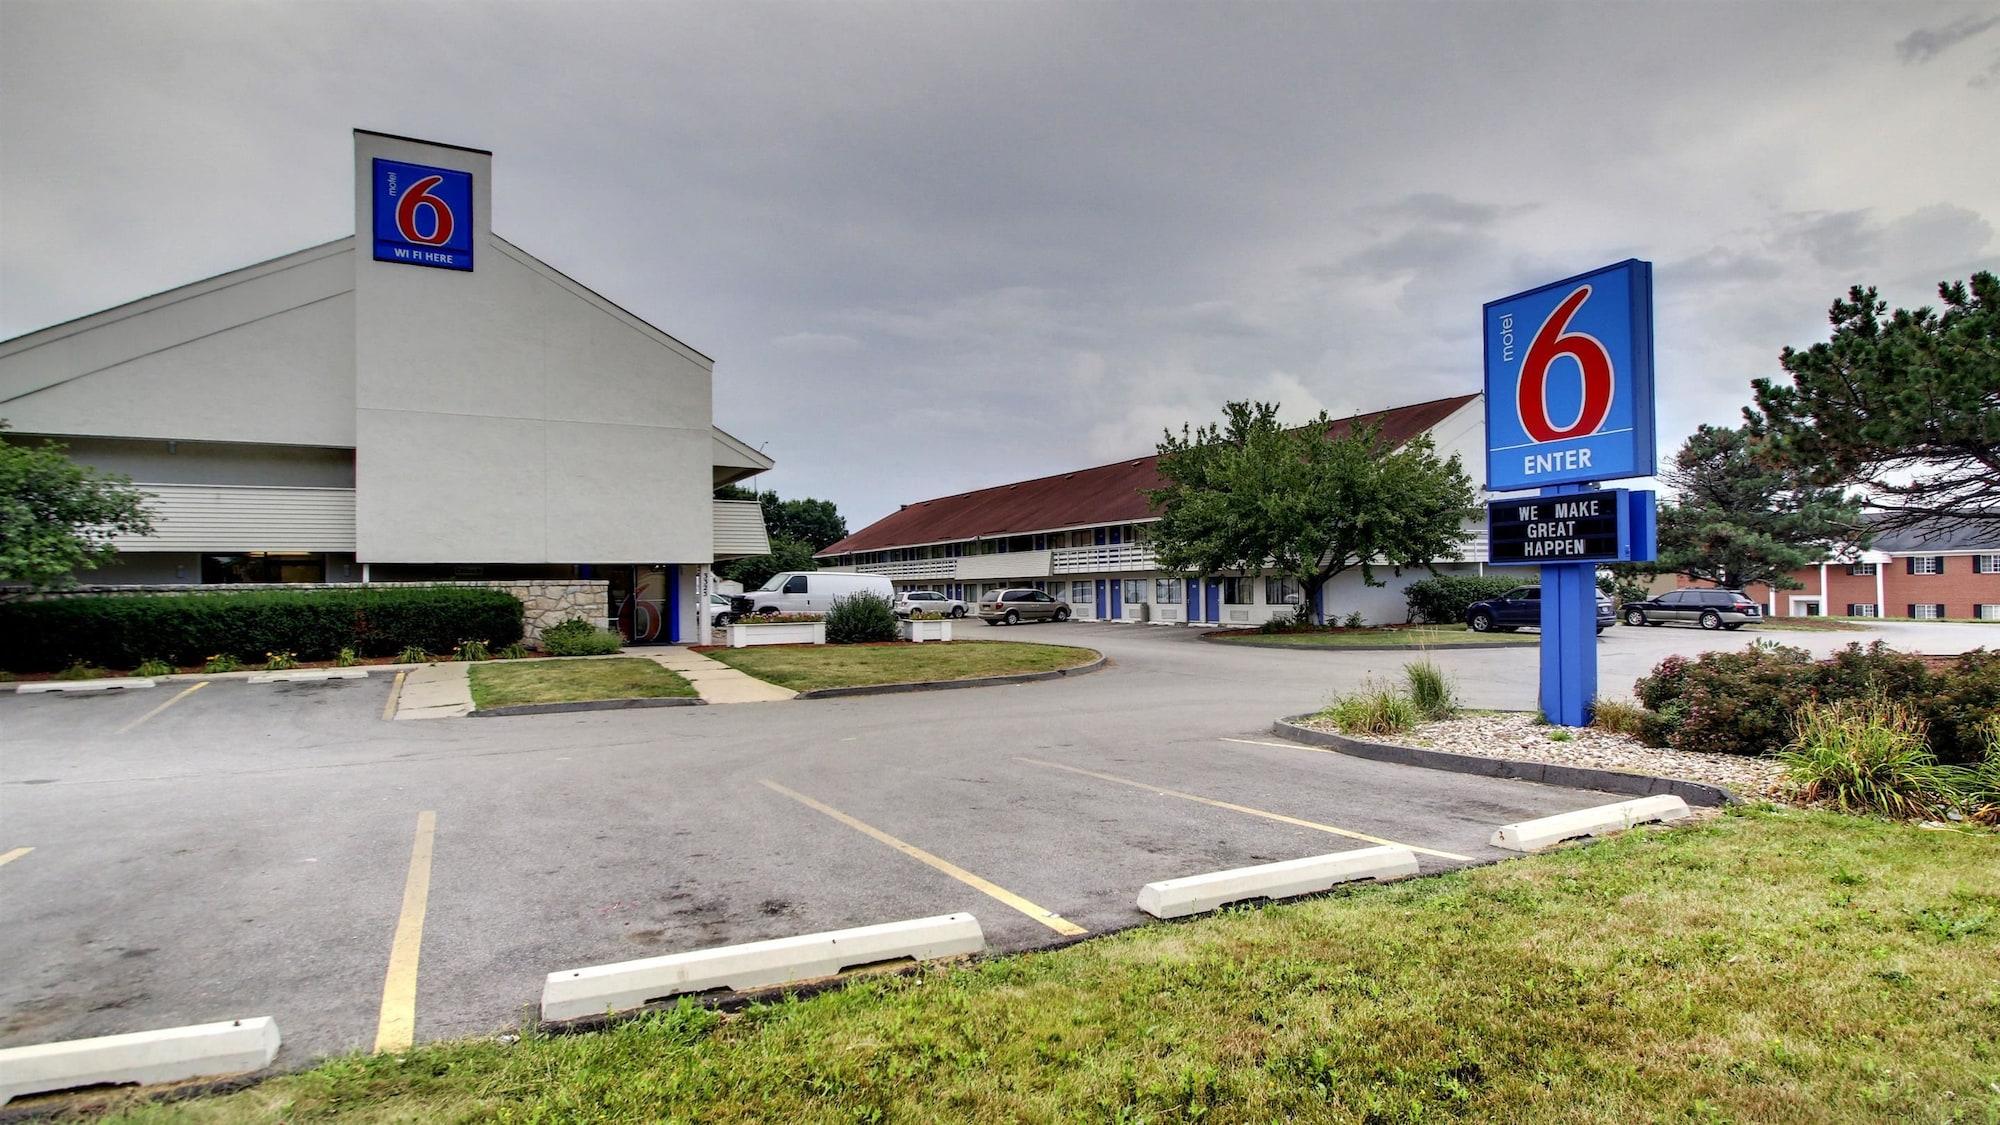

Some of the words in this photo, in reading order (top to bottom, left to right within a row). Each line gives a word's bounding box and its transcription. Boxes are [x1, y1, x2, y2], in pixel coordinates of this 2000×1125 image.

[387, 172, 397, 197] motel
[395, 175, 454, 247] 6
[394, 248, 409, 258] WI
[413, 250, 422, 260] FI
[426, 252, 453, 264] HERE
[1499, 313, 1513, 362] motel
[1516, 283, 1615, 443] 6
[1524, 448, 1592, 475] ENTER
[1519, 505, 1539, 521] WE
[1554, 500, 1599, 518] MAKE
[1527, 520, 1576, 539] GREAT
[1524, 538, 1585, 557] HAPPEN
